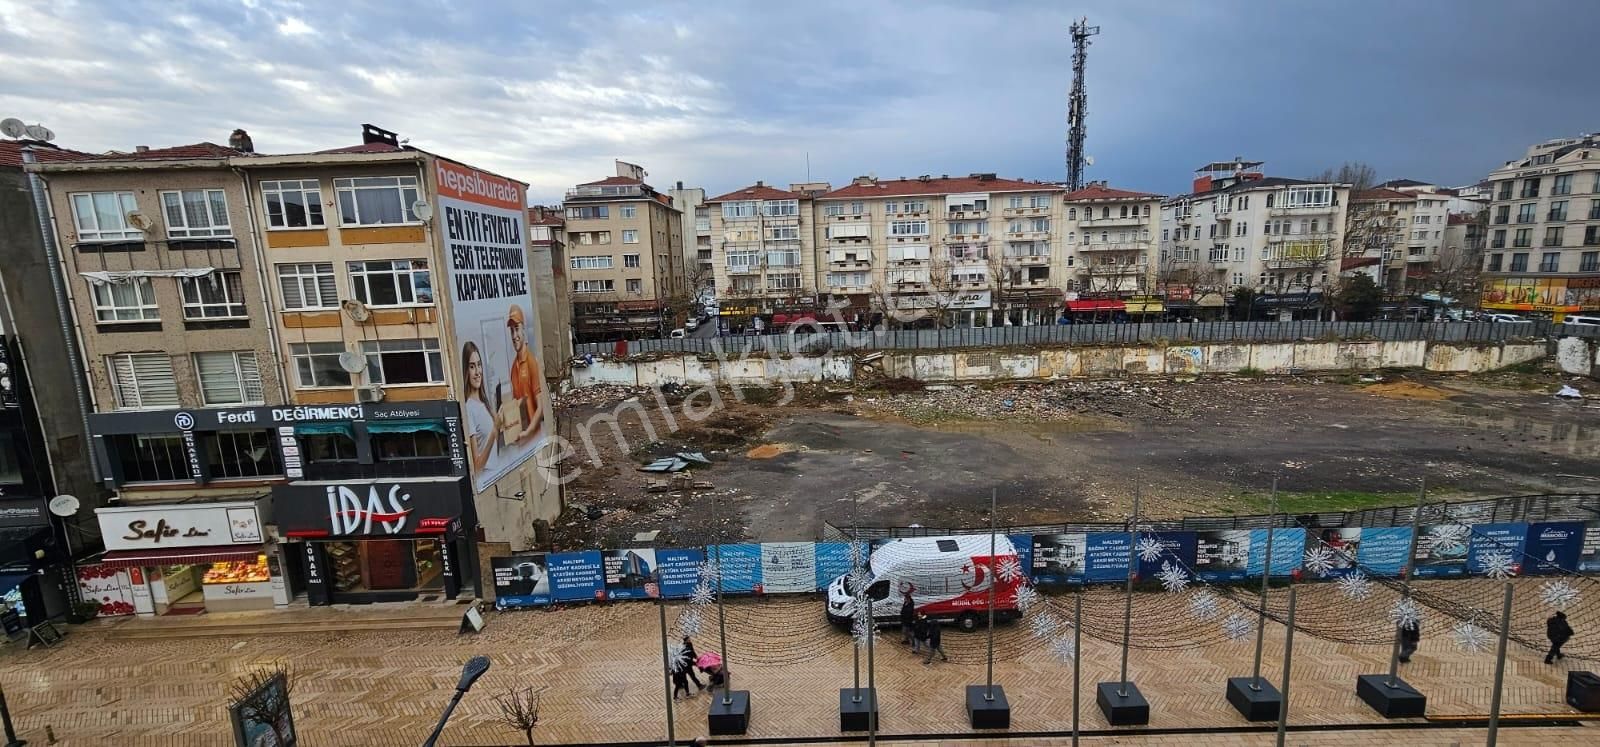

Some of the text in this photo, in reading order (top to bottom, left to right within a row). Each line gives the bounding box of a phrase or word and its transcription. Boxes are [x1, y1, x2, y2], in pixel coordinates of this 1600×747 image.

[436, 160, 518, 203] hepsiburada
[445, 206, 521, 245] EN İYİ FİYATLA
[451, 244, 524, 270] ESKİ TELEFONUNU
[455, 272, 527, 301] KAPINDA YENİLE
[217, 405, 420, 424] Ferdi DEĞİRMENCİ Saç Atölyesi
[123, 518, 180, 543] Safir
[305, 541, 318, 577] KONAK
[441, 543, 451, 571] KONAK
[85, 585, 102, 594] Safir
[224, 586, 244, 595] Safir
